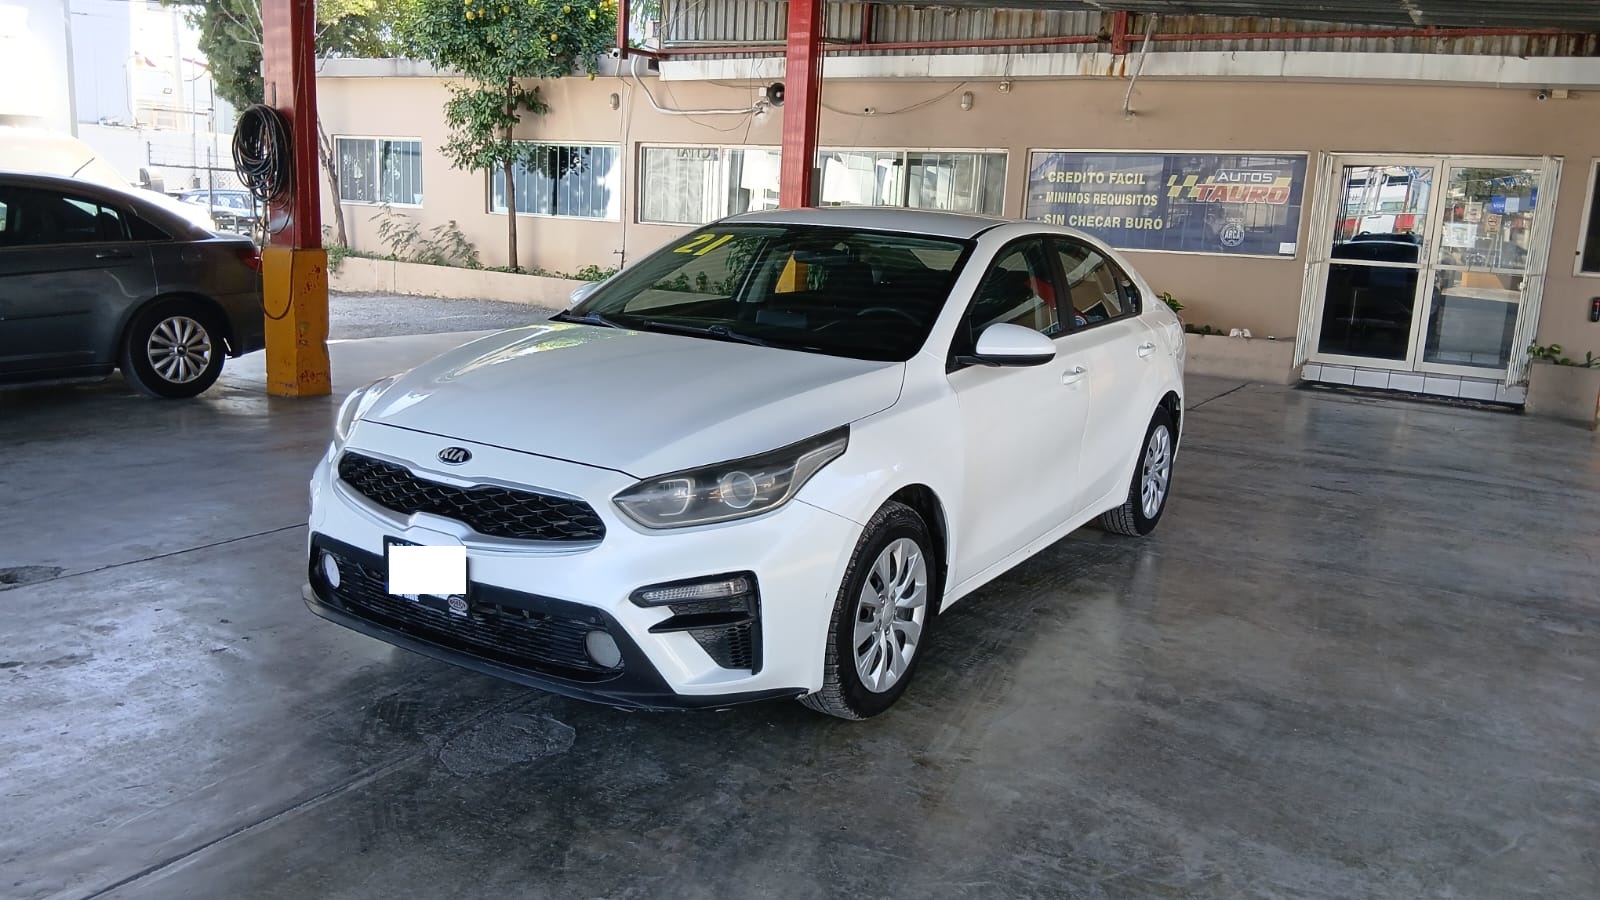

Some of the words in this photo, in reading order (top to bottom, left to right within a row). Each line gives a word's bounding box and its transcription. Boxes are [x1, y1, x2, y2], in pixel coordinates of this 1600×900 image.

[1048, 171, 1105, 184] CREDITO
[1109, 172, 1146, 185] FACIL
[1217, 172, 1273, 183] AUTOS
[1046, 191, 1090, 204] MINIMOS
[1093, 193, 1158, 206] REQUISITOS
[1196, 184, 1291, 204] TAURO
[1044, 213, 1065, 226] SIN
[1069, 215, 1121, 228] CHECAR
[1125, 215, 1163, 230] BURÓ
[673, 233, 735, 256] 21
[440, 448, 465, 462] KIA
